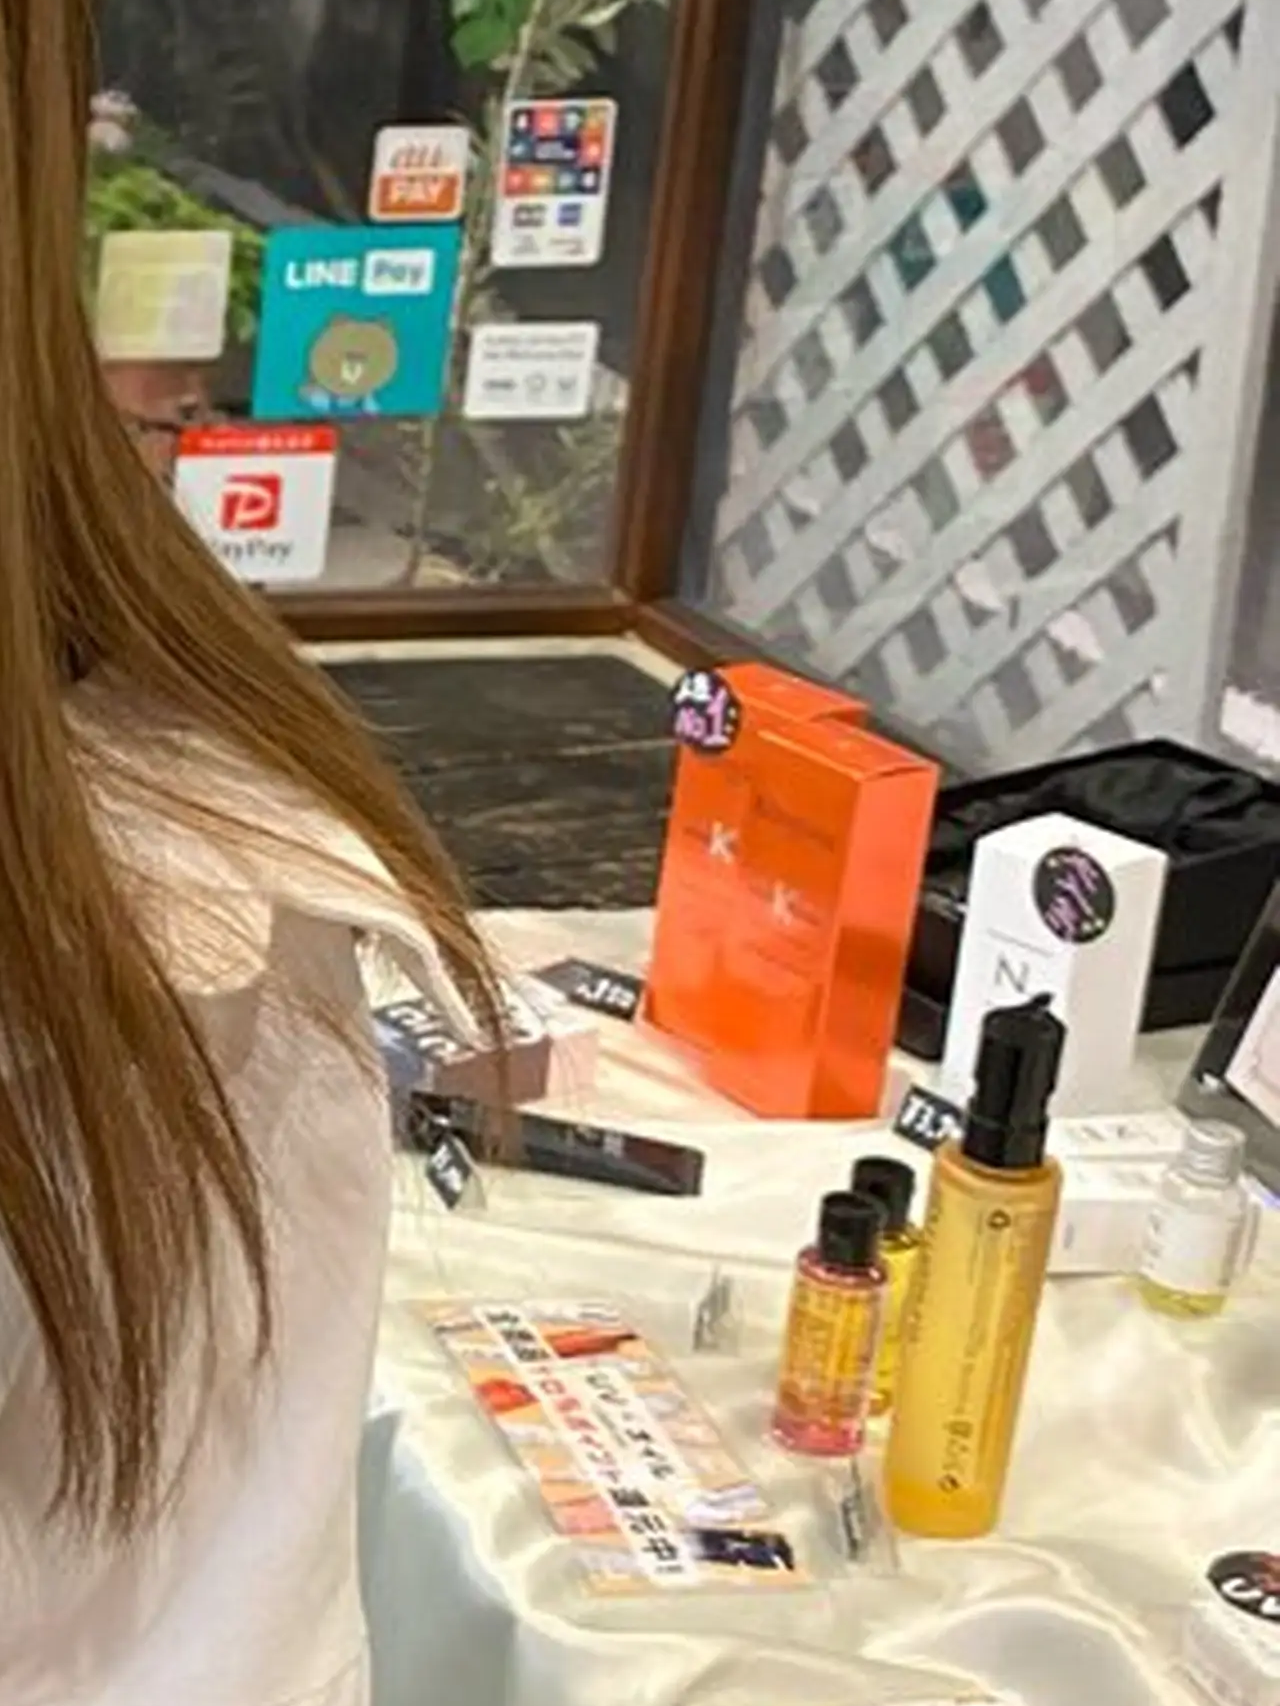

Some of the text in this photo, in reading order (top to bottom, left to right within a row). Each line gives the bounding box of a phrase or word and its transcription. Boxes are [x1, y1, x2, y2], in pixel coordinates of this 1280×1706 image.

[388, 177, 445, 204] PAY
[285, 257, 427, 289] LINE Pay
